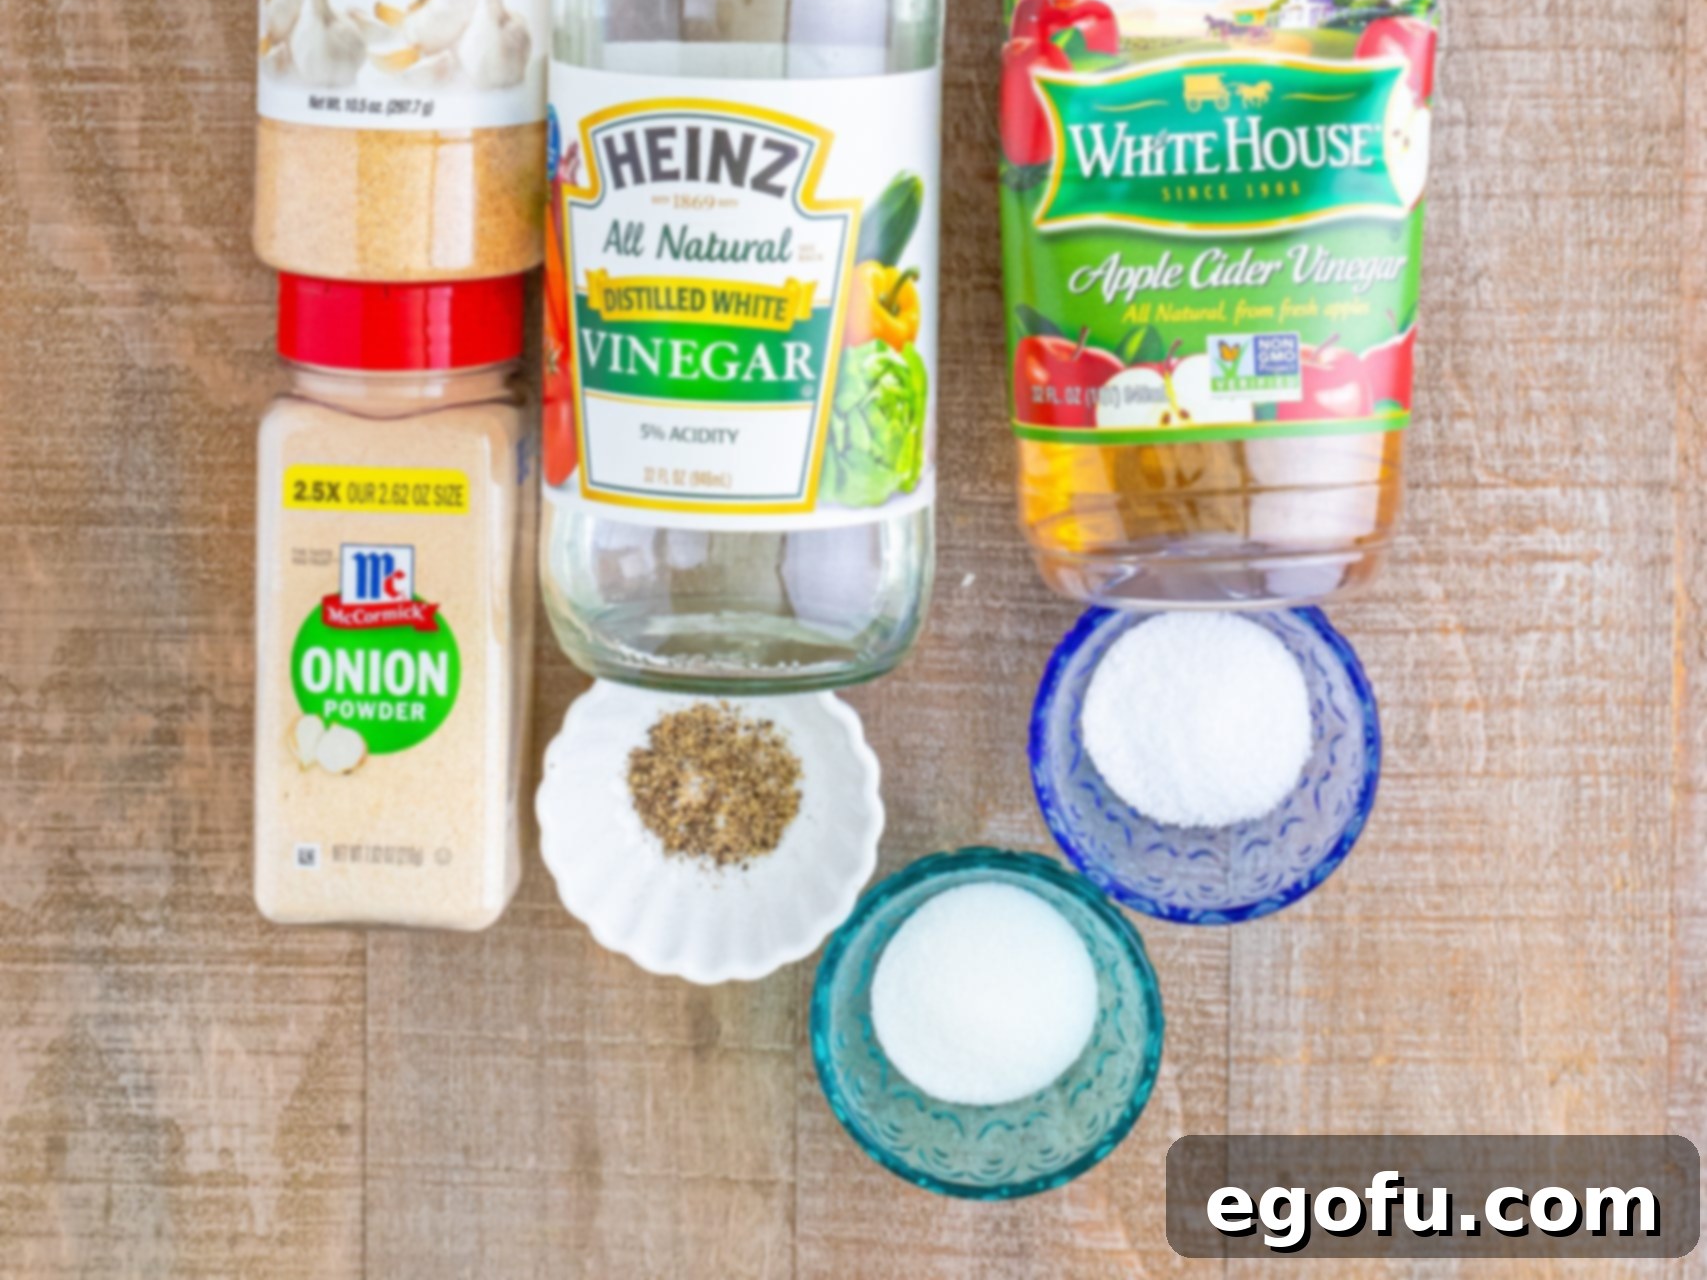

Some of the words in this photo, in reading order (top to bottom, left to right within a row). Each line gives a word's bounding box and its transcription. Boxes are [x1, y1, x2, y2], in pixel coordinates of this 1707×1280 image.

[602, 124, 801, 200] HEINZ
[672, 194, 717, 210] 1869
[1161, 183, 1228, 202] SINCE
[602, 218, 646, 258] All
[655, 222, 794, 264] Natural
[1068, 250, 1184, 305] Apple
[1189, 246, 1284, 291] Cider
[1286, 243, 1408, 293] Vinegar
[603, 284, 707, 314] DISTILLED
[711, 290, 791, 323] WHITE
[1122, 302, 1150, 324] All
[1233, 298, 1275, 325] from
[579, 326, 816, 384] VINEGAR
[1258, 336, 1296, 351] NON
[1258, 349, 1296, 363] GMO
[639, 422, 666, 441] 5%
[669, 425, 740, 445] ACIDITY
[293, 480, 341, 503] 2.5X
[346, 482, 377, 505] OUR
[378, 483, 409, 506] 2.62
[411, 484, 432, 507] OZ
[433, 484, 465, 508] SIZE
[327, 603, 428, 626] McCormick
[300, 644, 449, 697] ONION
[323, 699, 427, 722] POWDER
